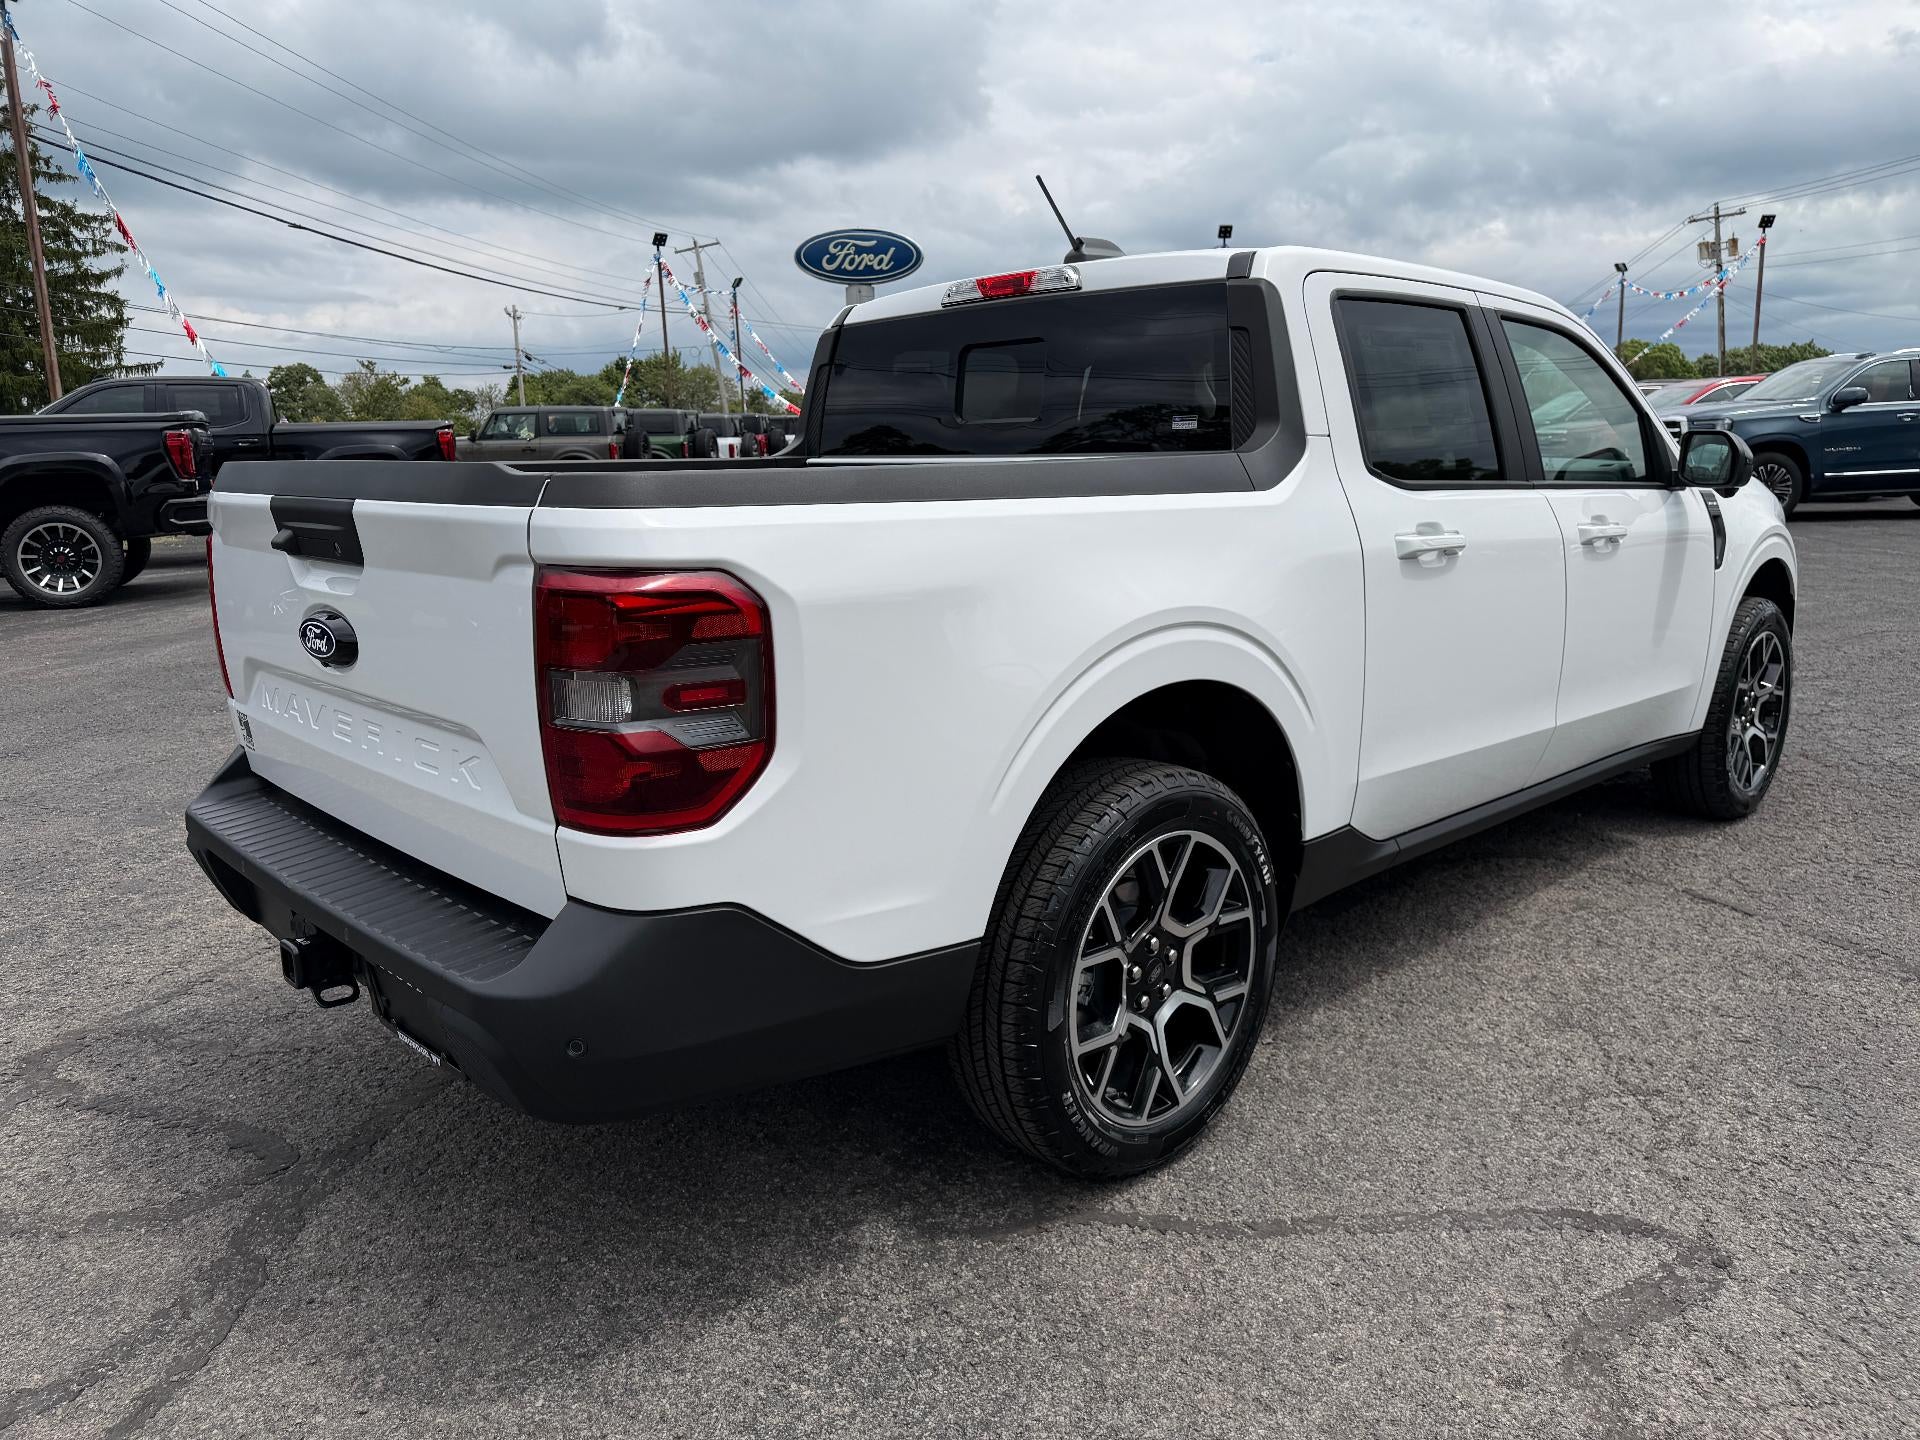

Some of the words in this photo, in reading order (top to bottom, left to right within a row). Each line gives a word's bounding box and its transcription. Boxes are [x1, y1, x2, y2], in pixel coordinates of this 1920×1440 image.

[821, 238, 896, 271] Ford
[305, 625, 328, 653] Ford
[261, 681, 481, 791] MAVERICK
[1226, 810, 1271, 885] GOODYEAR
